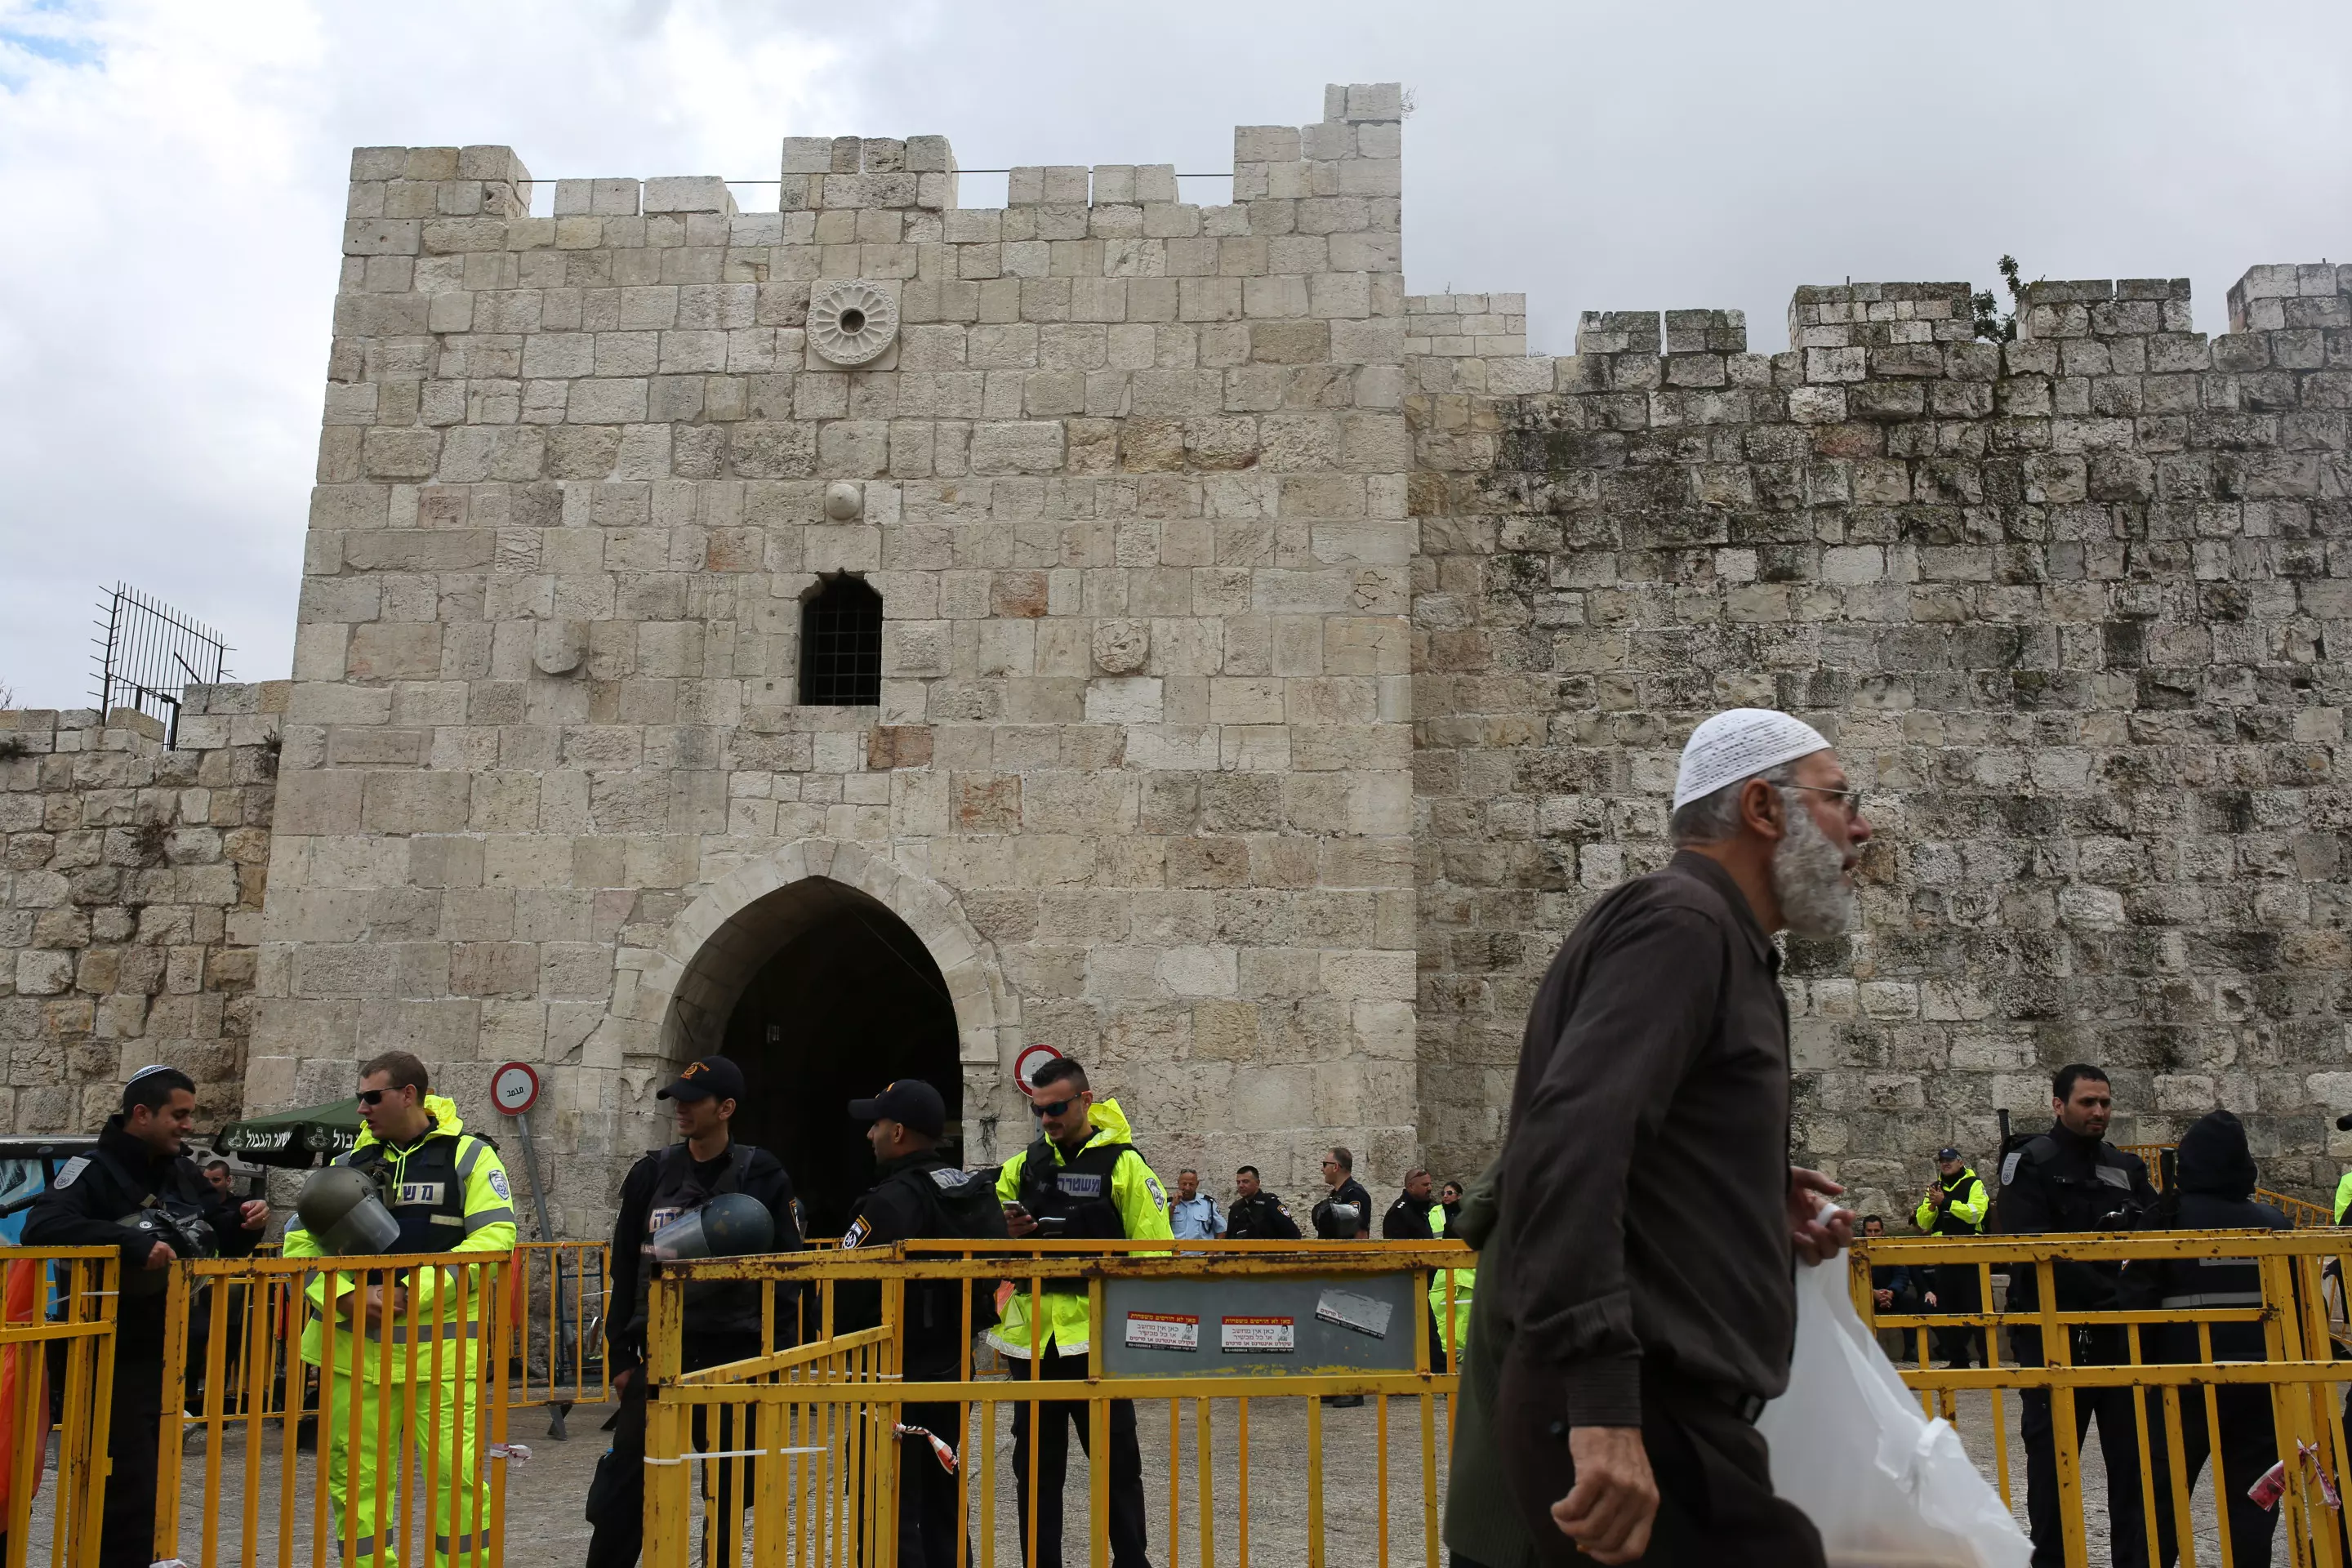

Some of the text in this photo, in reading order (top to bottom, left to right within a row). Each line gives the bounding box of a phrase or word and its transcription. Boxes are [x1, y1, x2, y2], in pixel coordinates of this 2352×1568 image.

[245, 1128, 272, 1149] הגבול
[332, 1128, 359, 1149] בול
[1057, 1177, 1101, 1192] משטרה
[654, 1212, 679, 1228] רה
